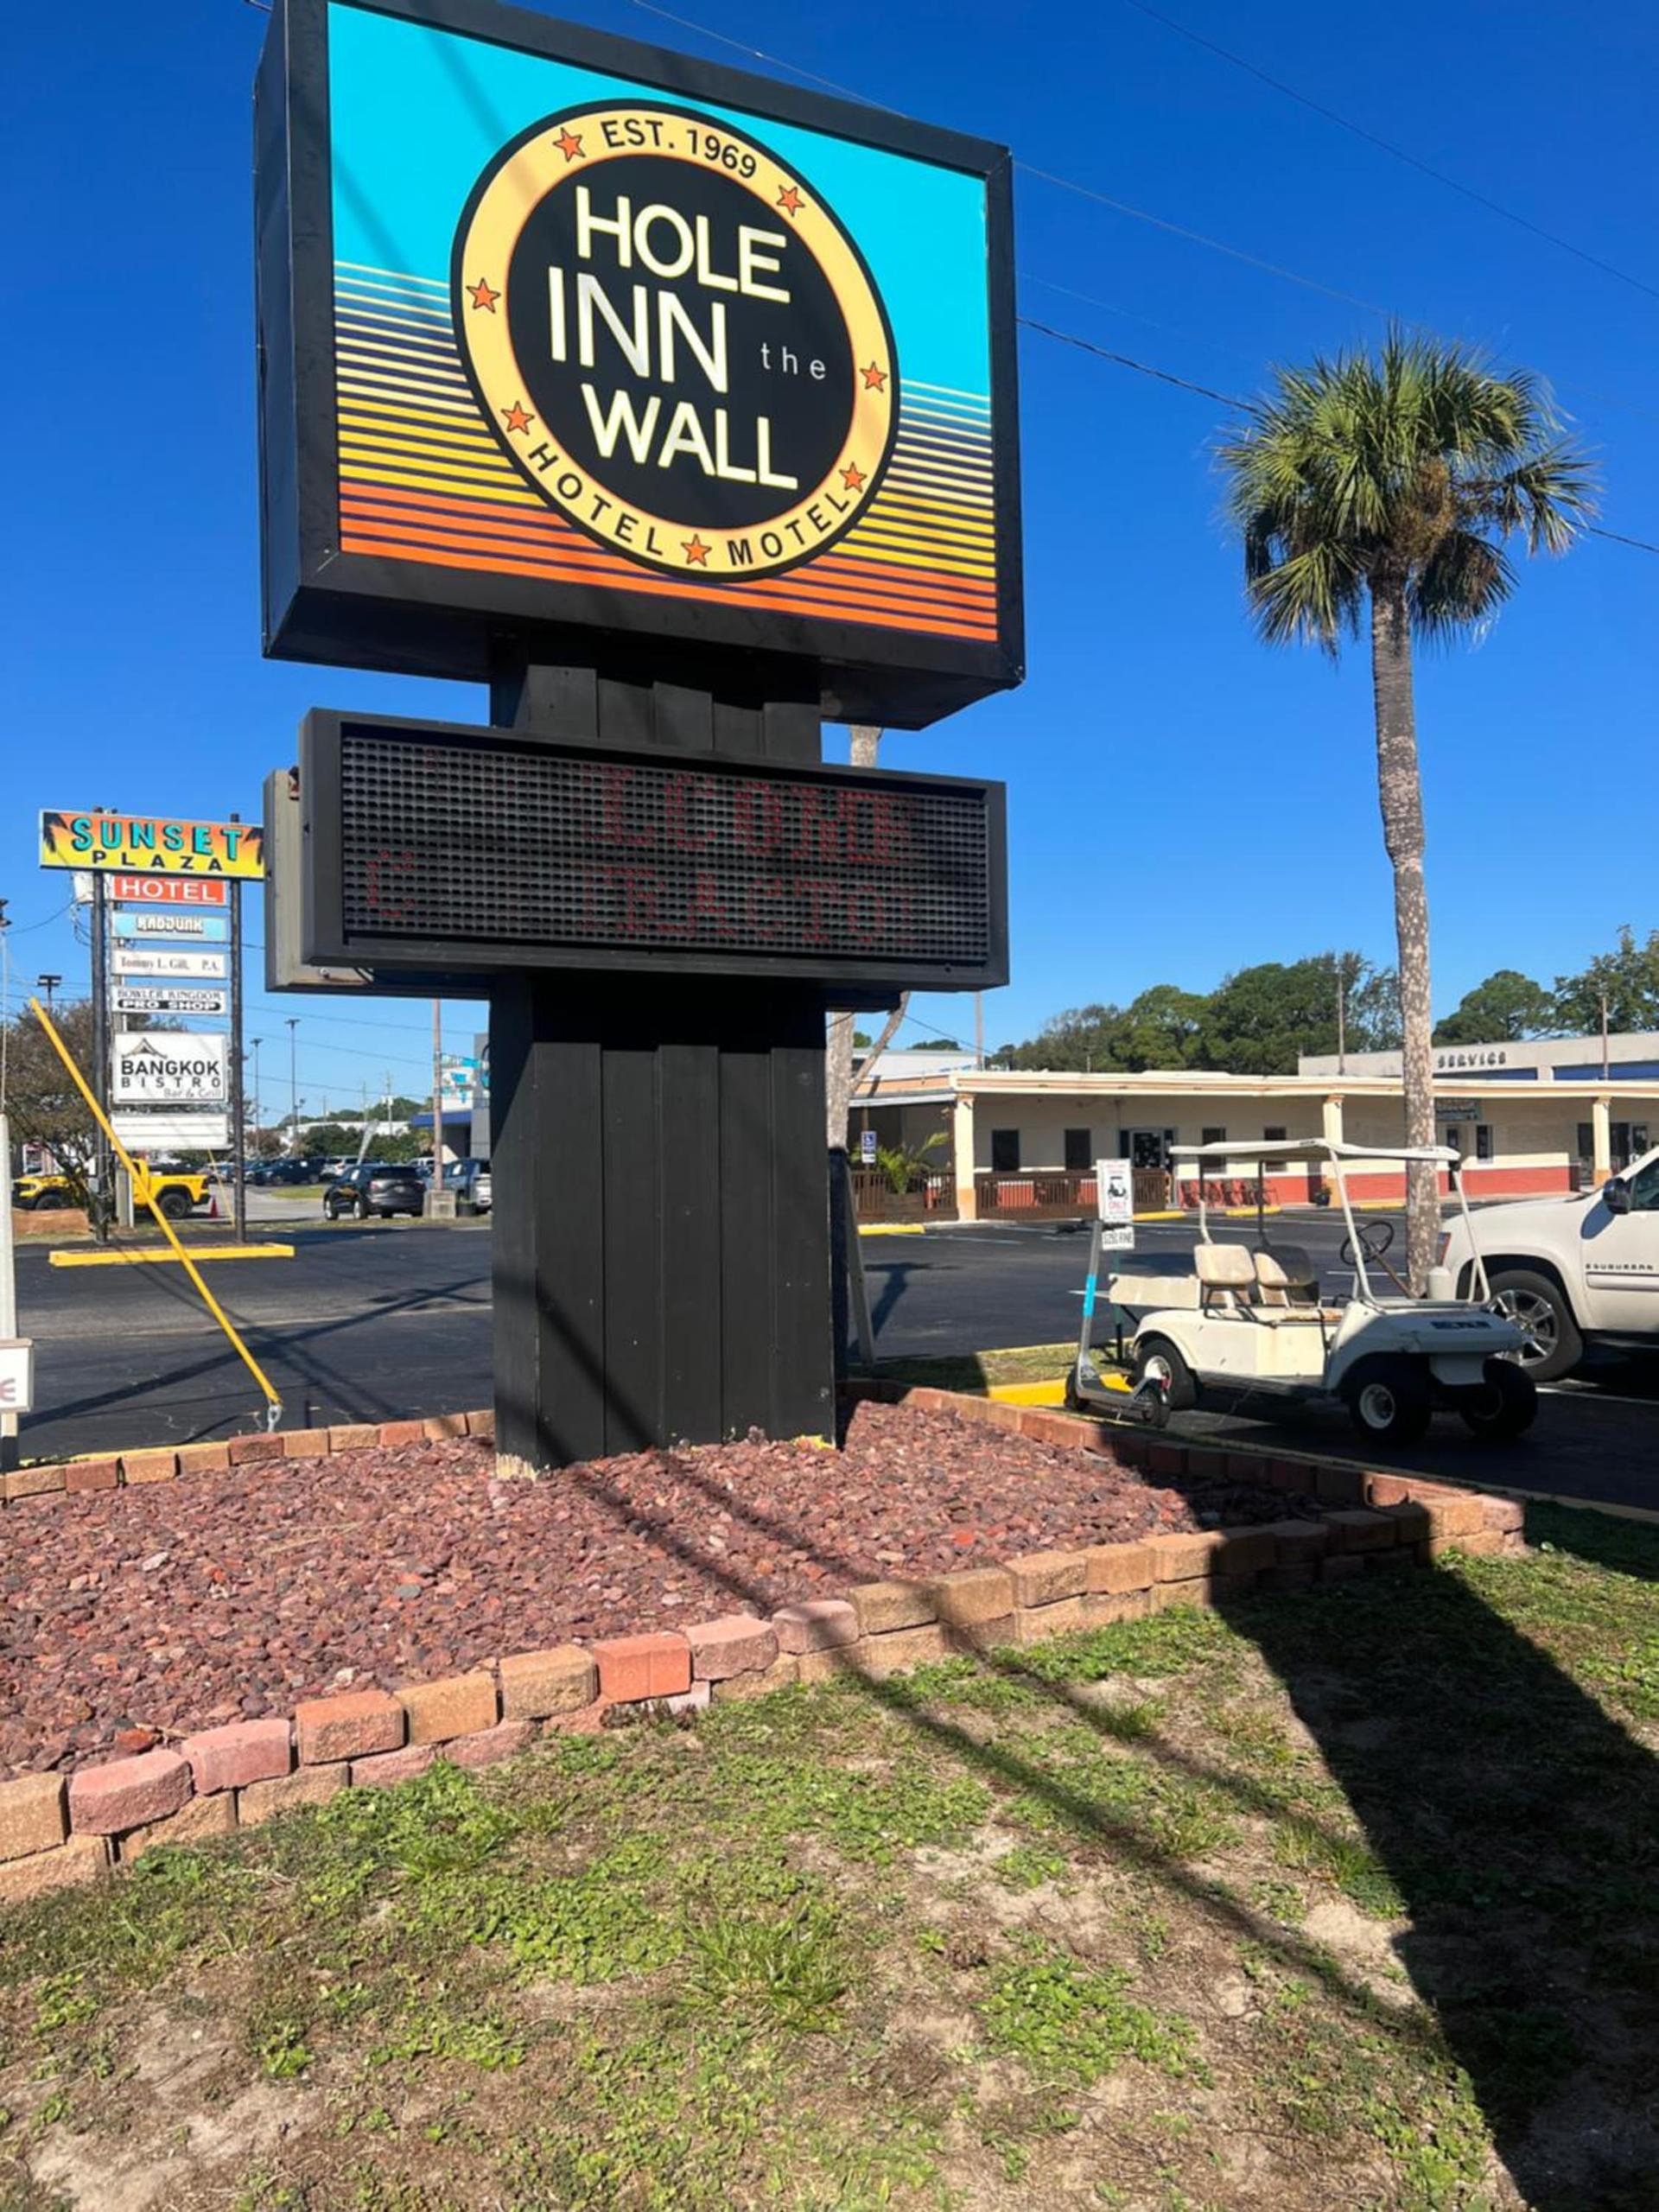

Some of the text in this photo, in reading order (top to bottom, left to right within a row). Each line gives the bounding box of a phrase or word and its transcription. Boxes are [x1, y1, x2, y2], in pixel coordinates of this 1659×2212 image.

[601, 119, 757, 180] EST. 1969
[575, 185, 791, 303] HOLE
[548, 265, 826, 393] INN the
[581, 383, 798, 490] WALL
[528, 442, 849, 567] HOTEL MOTEL
[71, 817, 242, 861] SUNSET
[92, 850, 223, 871] PLAZA
[121, 880, 218, 901] HOTEL
[123, 1000, 217, 1010] PRO SHOP
[121, 1060, 219, 1075] BANGKOK
[1438, 1051, 1506, 1068] SERVICE
[121, 1077, 221, 1088] BISTRO
